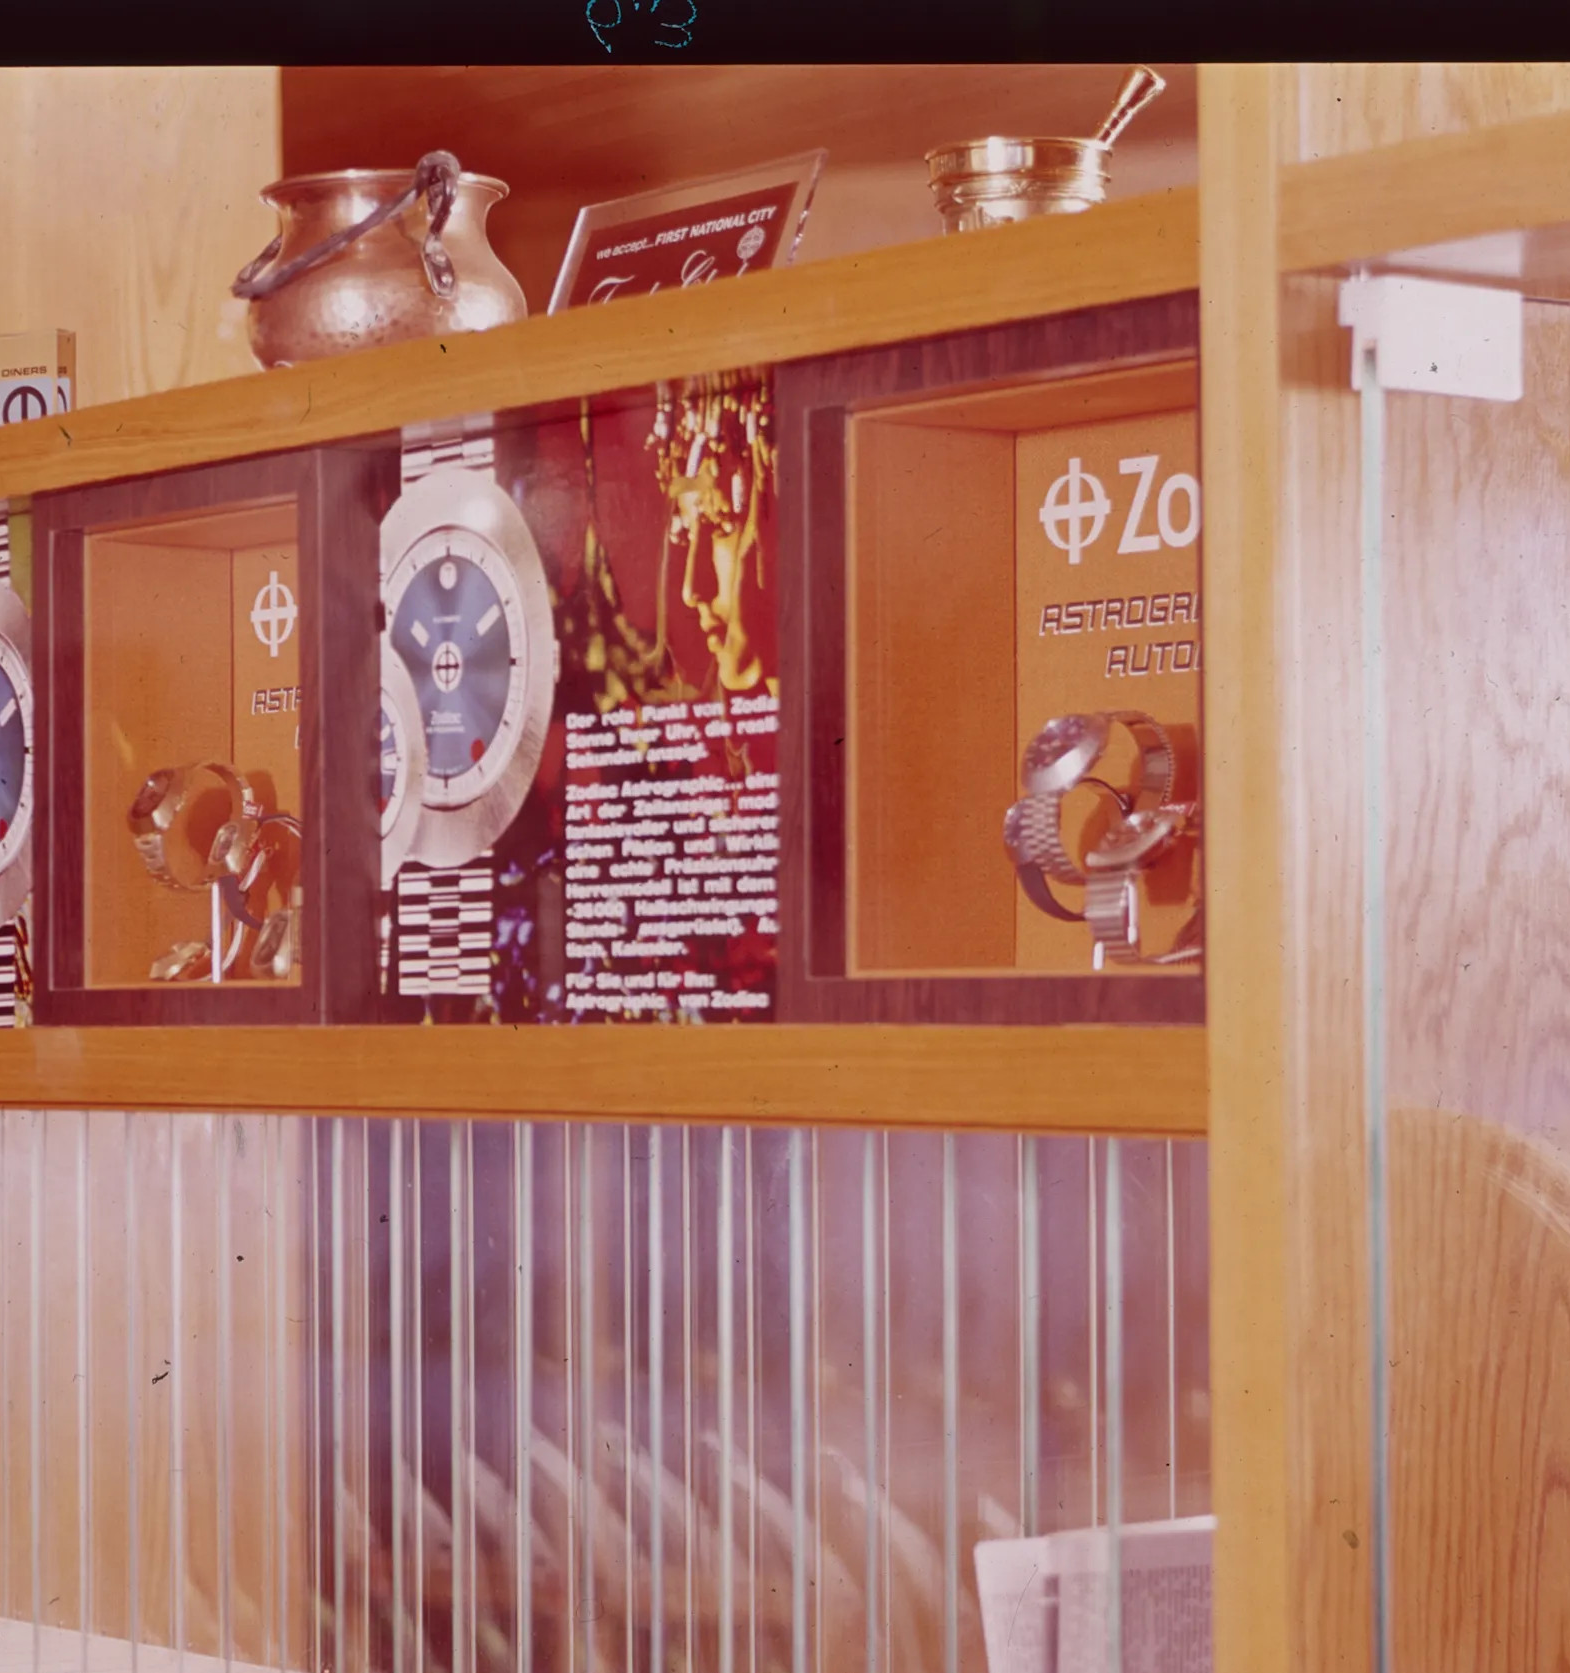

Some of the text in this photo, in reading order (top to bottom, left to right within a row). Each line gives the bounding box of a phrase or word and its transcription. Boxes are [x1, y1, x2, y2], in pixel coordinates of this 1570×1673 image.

[596, 249, 611, 260] we
[655, 226, 690, 246] FIRST
[690, 214, 747, 238] NATIONAL
[747, 206, 778, 225] CITY
[1, 366, 47, 377] DINERS
[1038, 592, 1200, 637] ASTROGR
[1104, 640, 1201, 678] AUTO
[566, 713, 597, 729] Der
[602, 709, 635, 727] rote
[642, 703, 688, 722] Punkt
[693, 702, 723, 718] von
[566, 732, 616, 750] Sonne
[665, 723, 701, 741] Uhr,
[704, 720, 732, 737] die
[566, 743, 709, 769] Sekunden anzeigt.
[566, 783, 619, 801] Zodiac
[566, 804, 591, 821] Art
[597, 803, 628, 819] der
[673, 818, 706, 834] und
[683, 837, 716, 853] und
[566, 864, 600, 880] eine
[609, 861, 655, 878] echte
[566, 877, 776, 899] Herrenmodell ist mit dem
[611, 940, 689, 957] Kalender.
[566, 972, 594, 990] Für
[597, 972, 622, 989] Sie
[624, 972, 655, 988] und
[658, 972, 682, 988] für
[566, 991, 769, 1013] Astrographic von Zodiac
